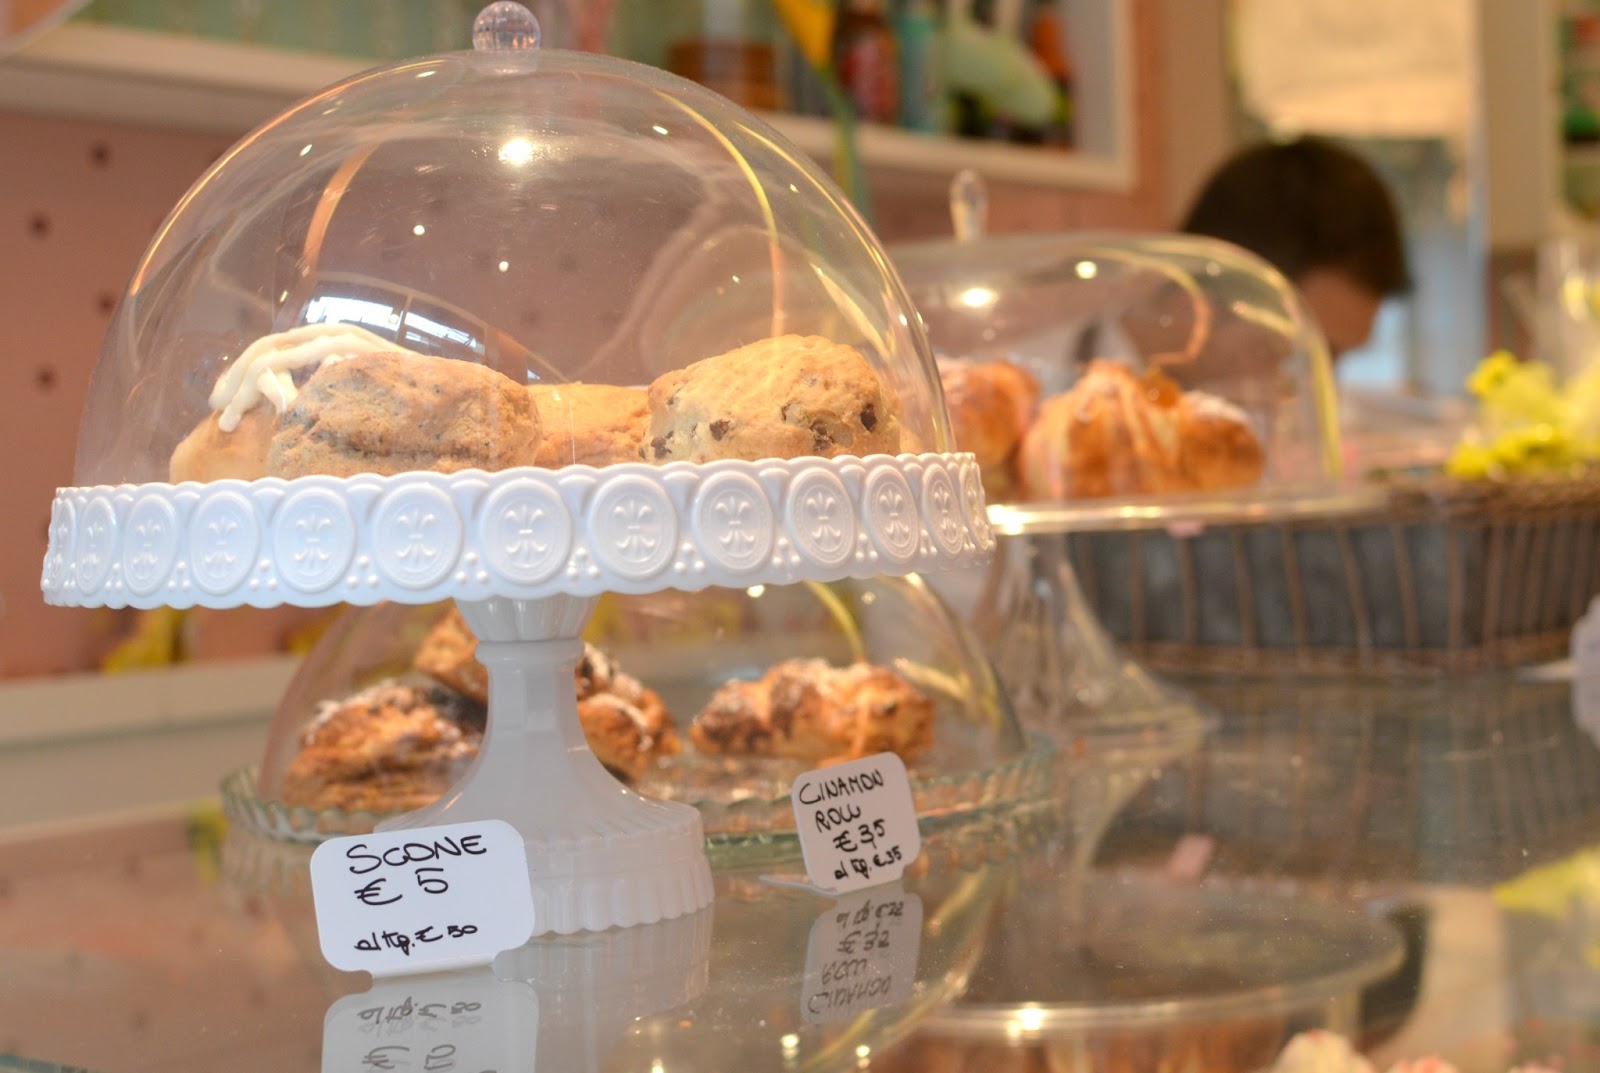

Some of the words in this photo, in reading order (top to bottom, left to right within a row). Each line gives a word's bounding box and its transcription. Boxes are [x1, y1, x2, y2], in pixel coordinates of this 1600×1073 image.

[799, 769, 884, 805] CINAMON
[815, 804, 862, 833] ROLL
[346, 835, 487, 874] SCONE
[832, 830, 858, 852] €
[354, 878, 402, 906] €
[414, 868, 449, 894] 5
